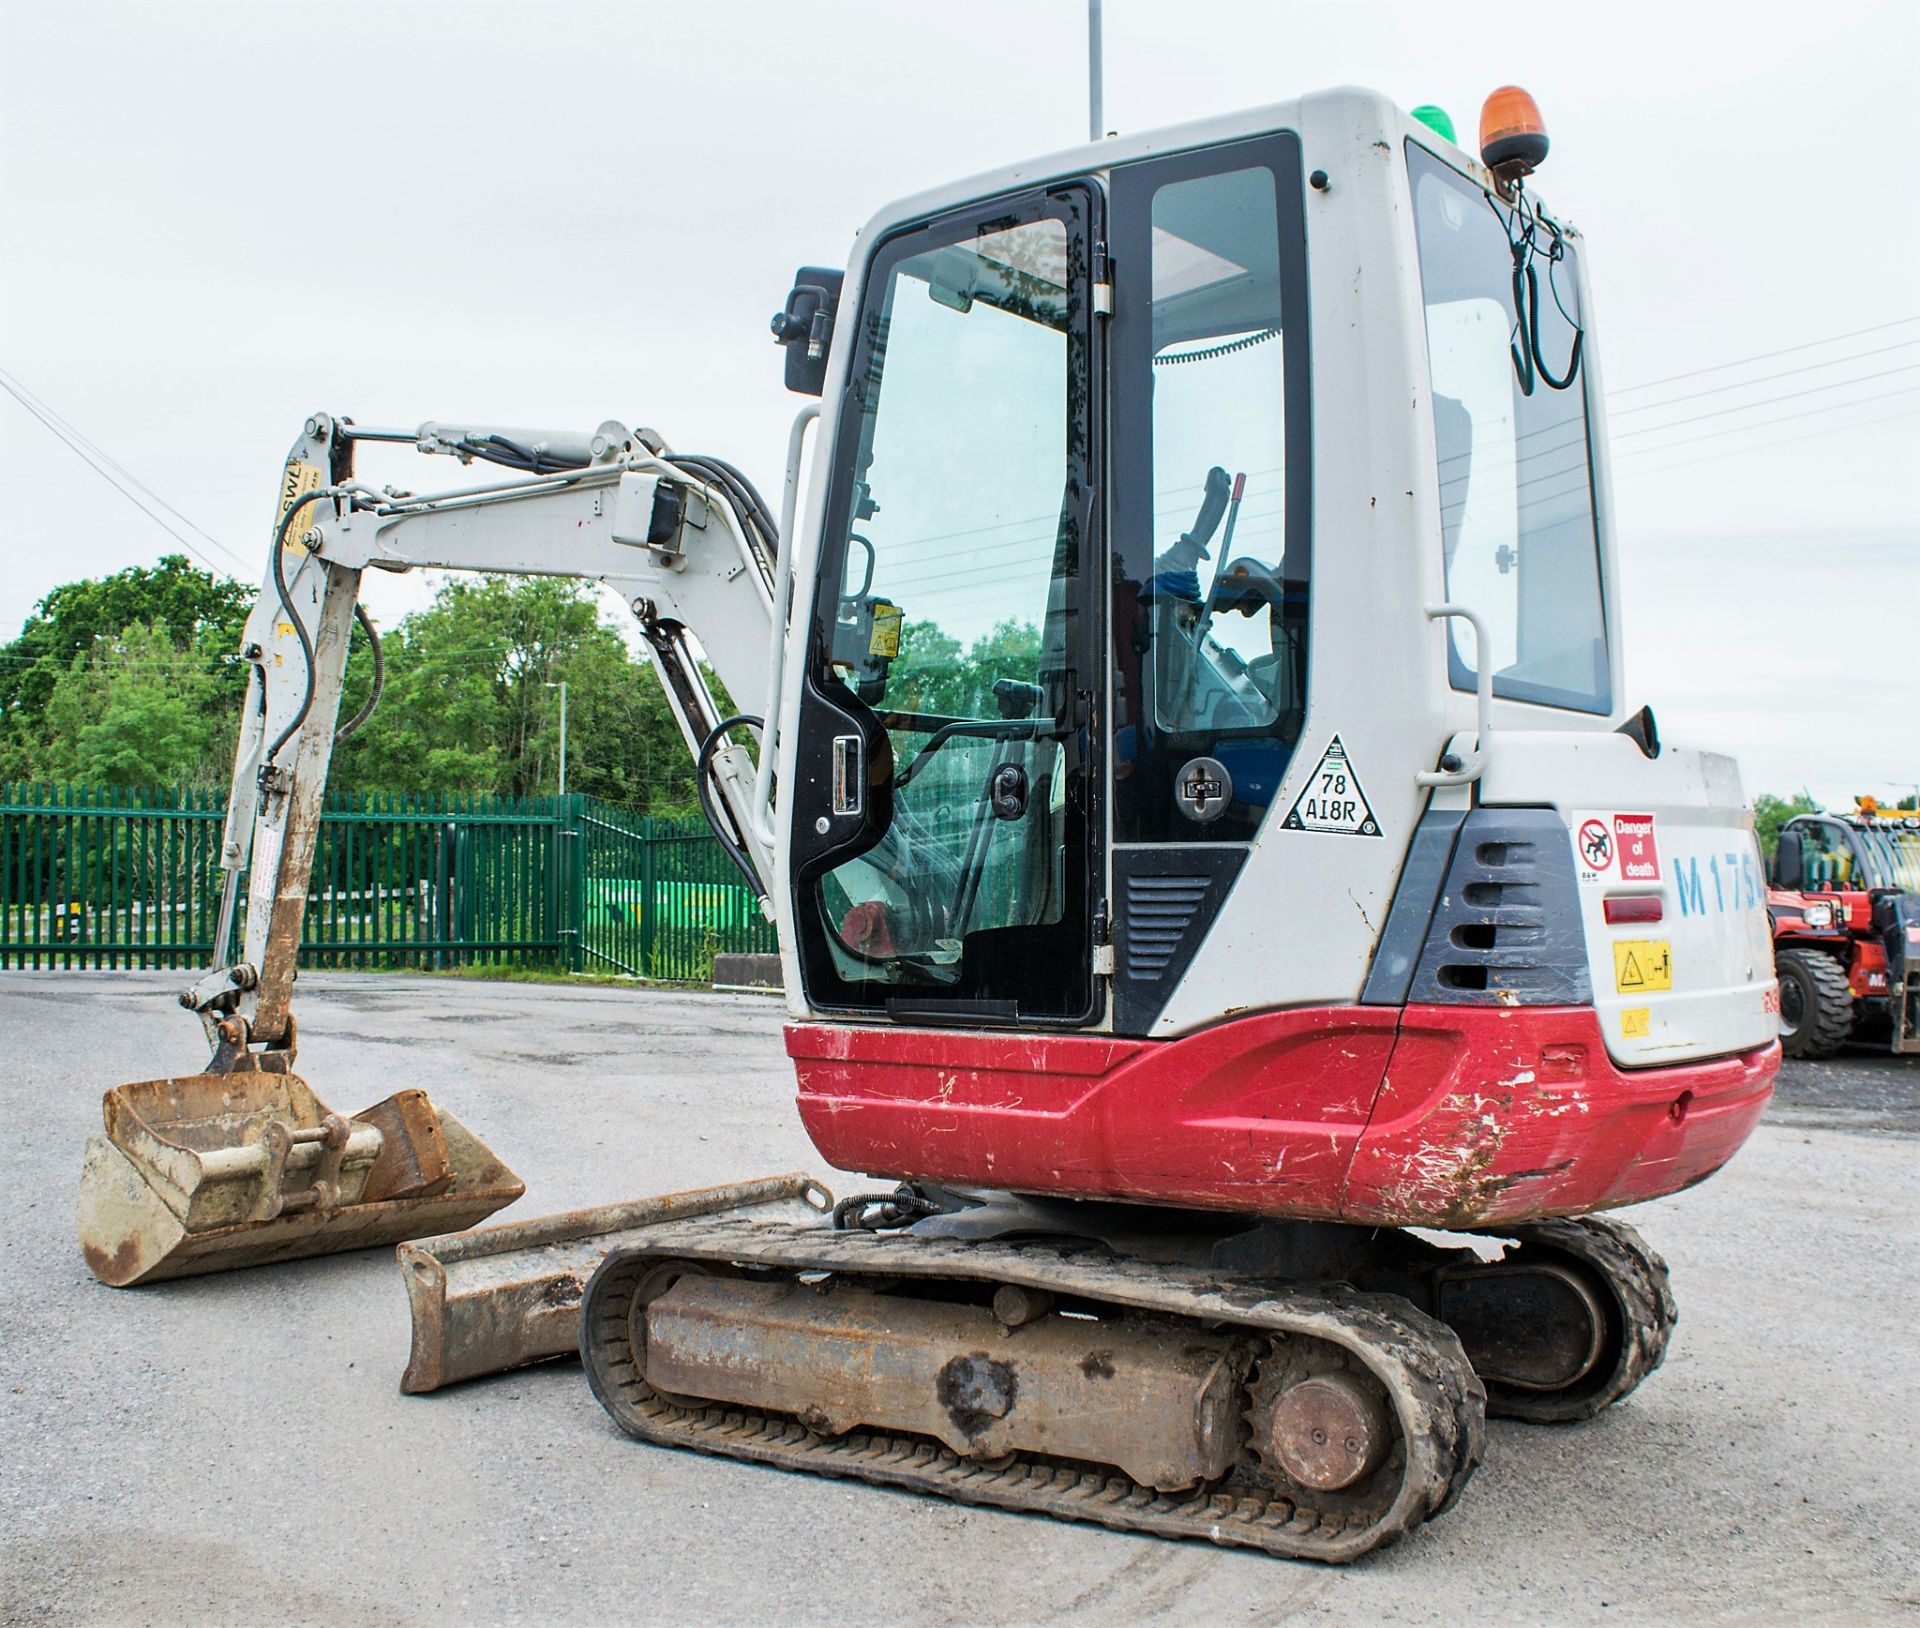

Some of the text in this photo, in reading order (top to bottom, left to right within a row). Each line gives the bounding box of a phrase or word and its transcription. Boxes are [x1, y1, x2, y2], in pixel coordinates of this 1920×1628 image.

[1322, 774, 1346, 795] 78
[1615, 819, 1653, 838] Danger
[1632, 841, 1643, 856] of
[1626, 862, 1655, 877] death
